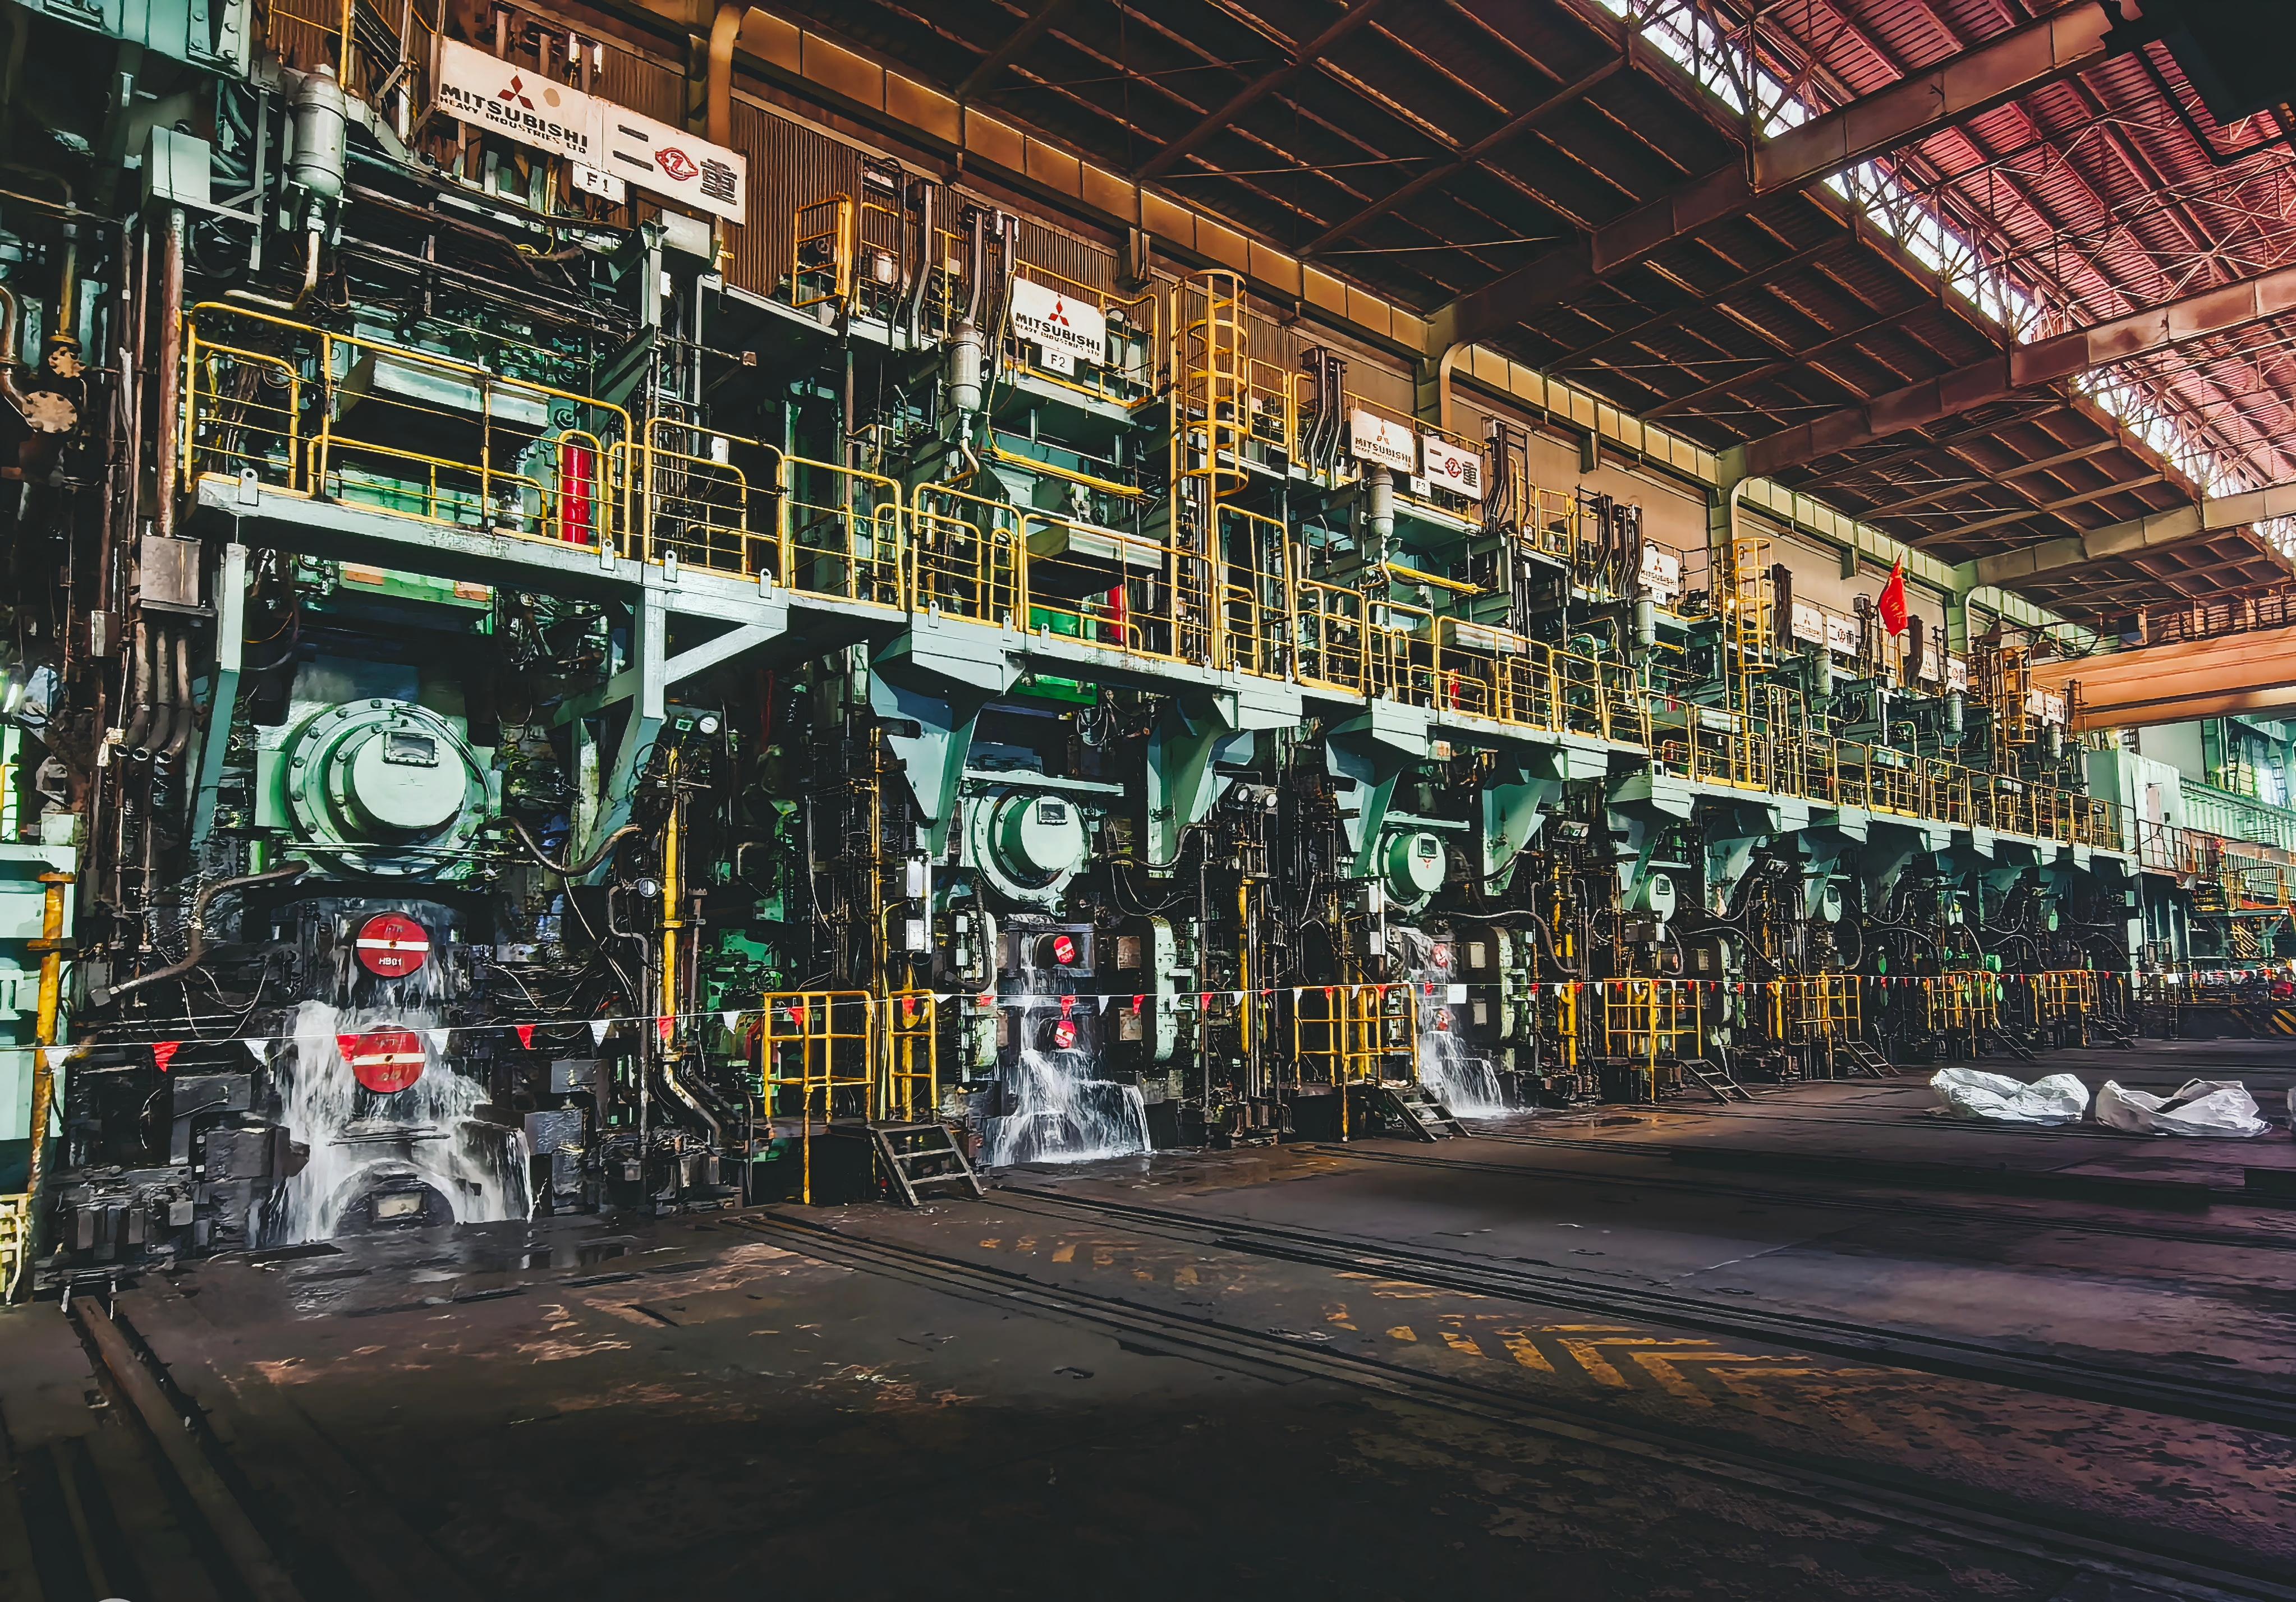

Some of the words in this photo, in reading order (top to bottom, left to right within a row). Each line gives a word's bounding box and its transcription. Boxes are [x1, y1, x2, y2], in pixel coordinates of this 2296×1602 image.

[439, 95, 478, 114] HEAVY
[485, 113, 561, 144] INDUSTRIES
[440, 83, 587, 148] MITSUBISHI
[1015, 312, 1100, 352] MITSUBISHI
[1051, 354, 1065, 368] F2
